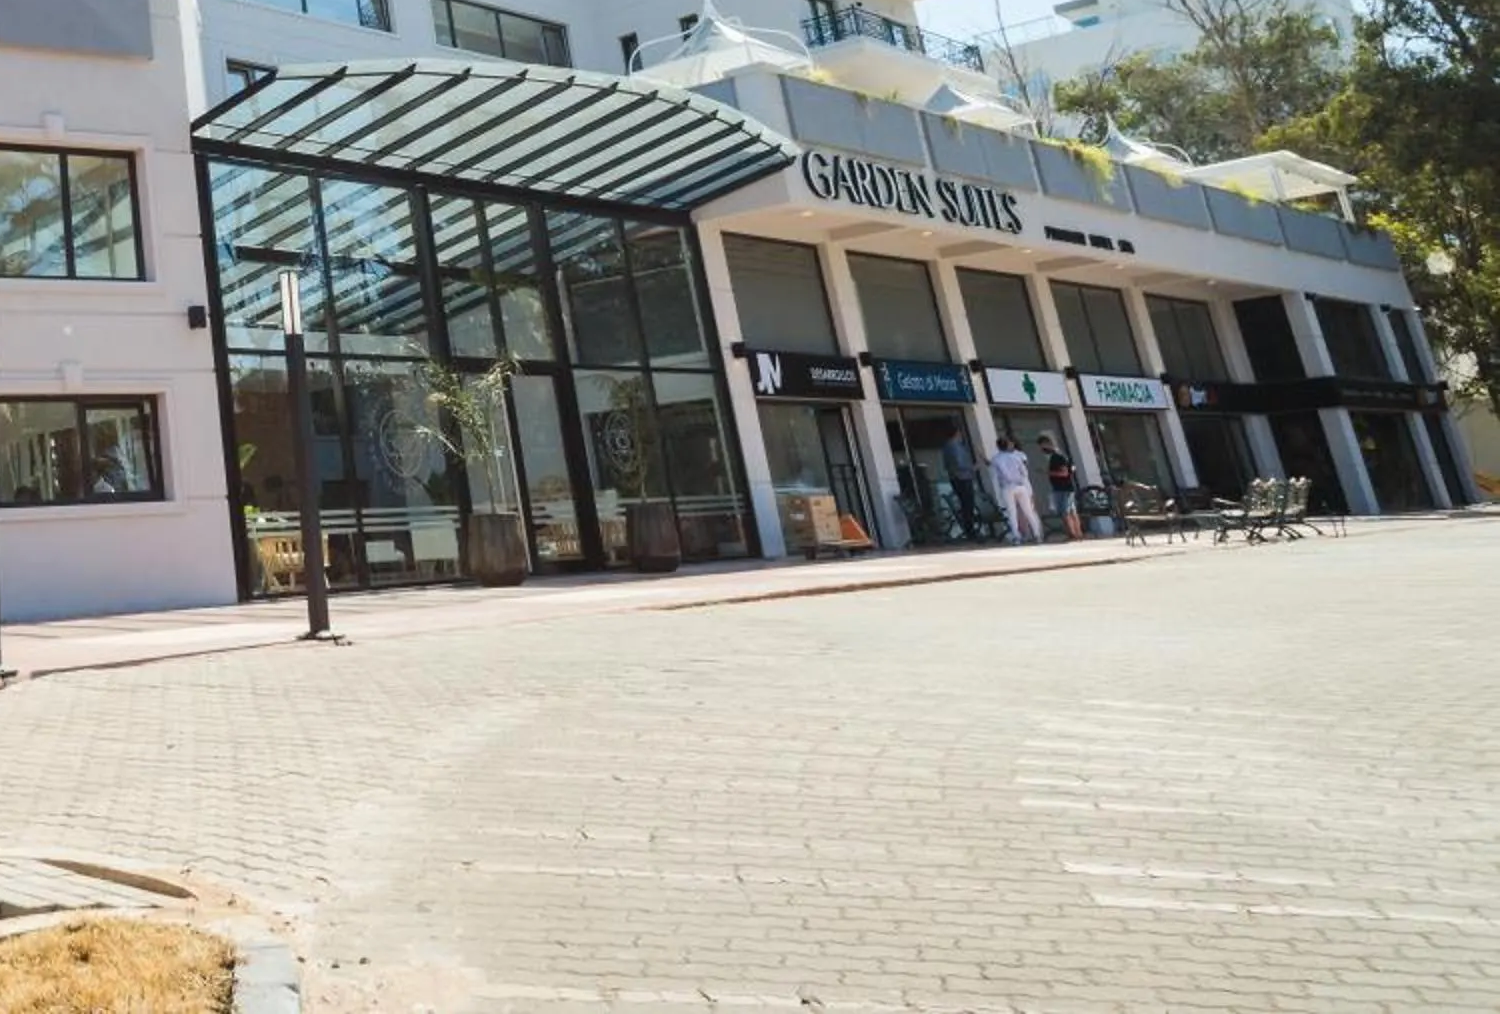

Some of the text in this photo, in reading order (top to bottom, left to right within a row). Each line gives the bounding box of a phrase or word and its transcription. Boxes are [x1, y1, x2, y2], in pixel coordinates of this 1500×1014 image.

[801, 152, 1023, 234] GARDEN SUITES
[1096, 380, 1155, 404] FARMACIA
